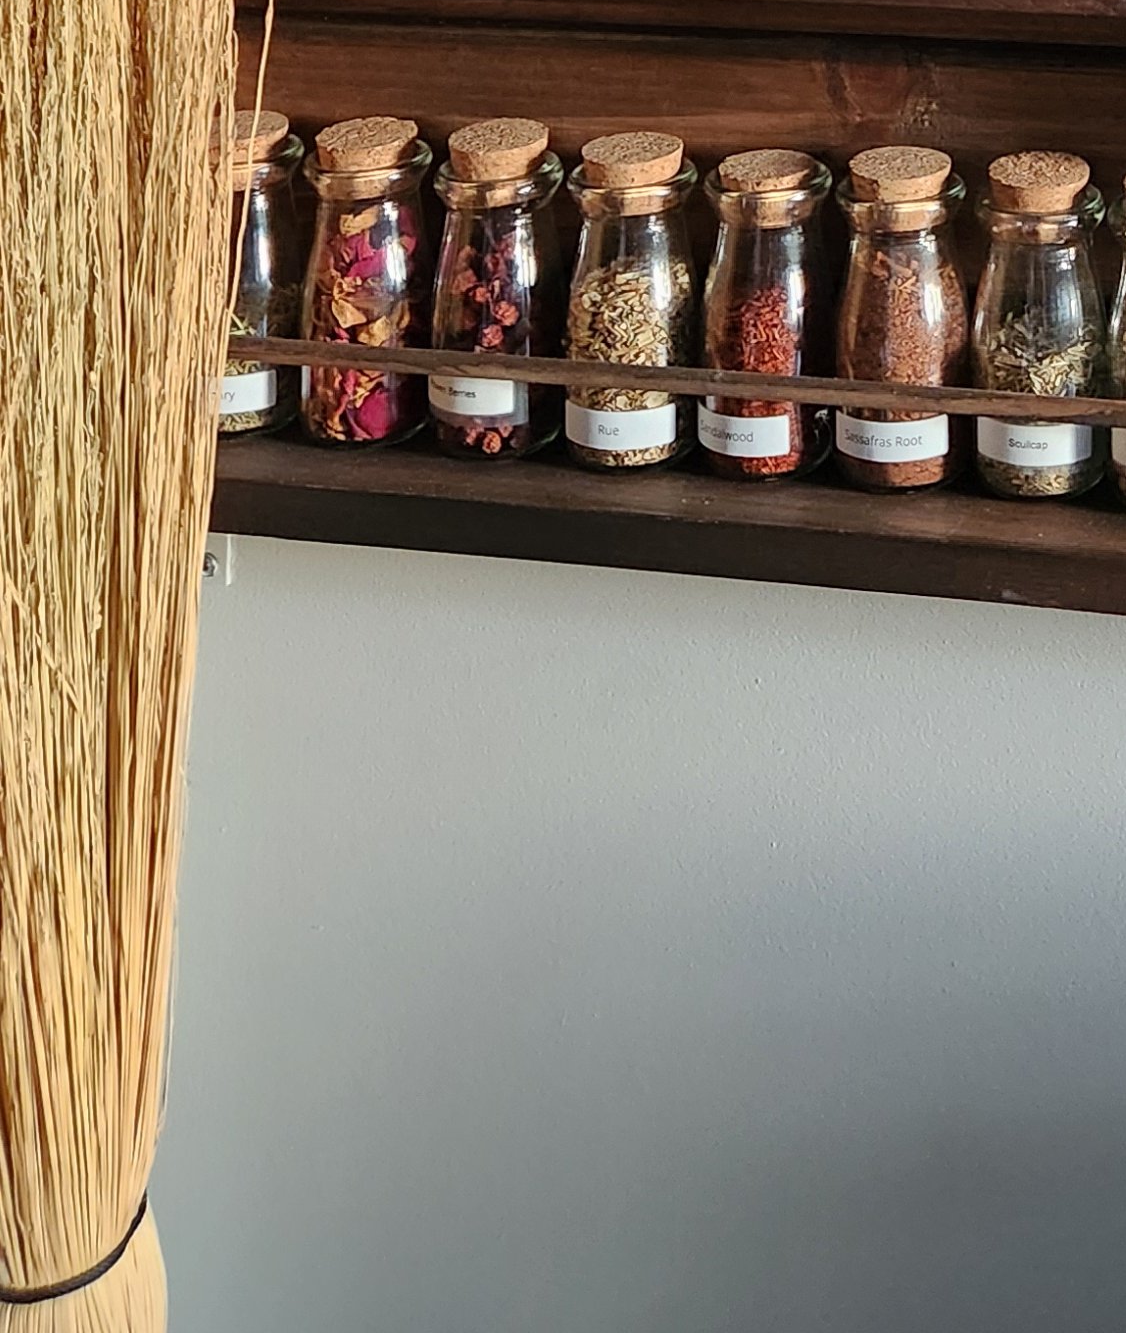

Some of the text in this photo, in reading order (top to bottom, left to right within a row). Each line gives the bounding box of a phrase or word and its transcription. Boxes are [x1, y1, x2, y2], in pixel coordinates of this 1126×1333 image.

[598, 424, 620, 436] Rue
[700, 420, 754, 442] Sandalwood
[845, 429, 922, 448] Sassafras Root
[1008, 437, 1049, 450] Scullcap
